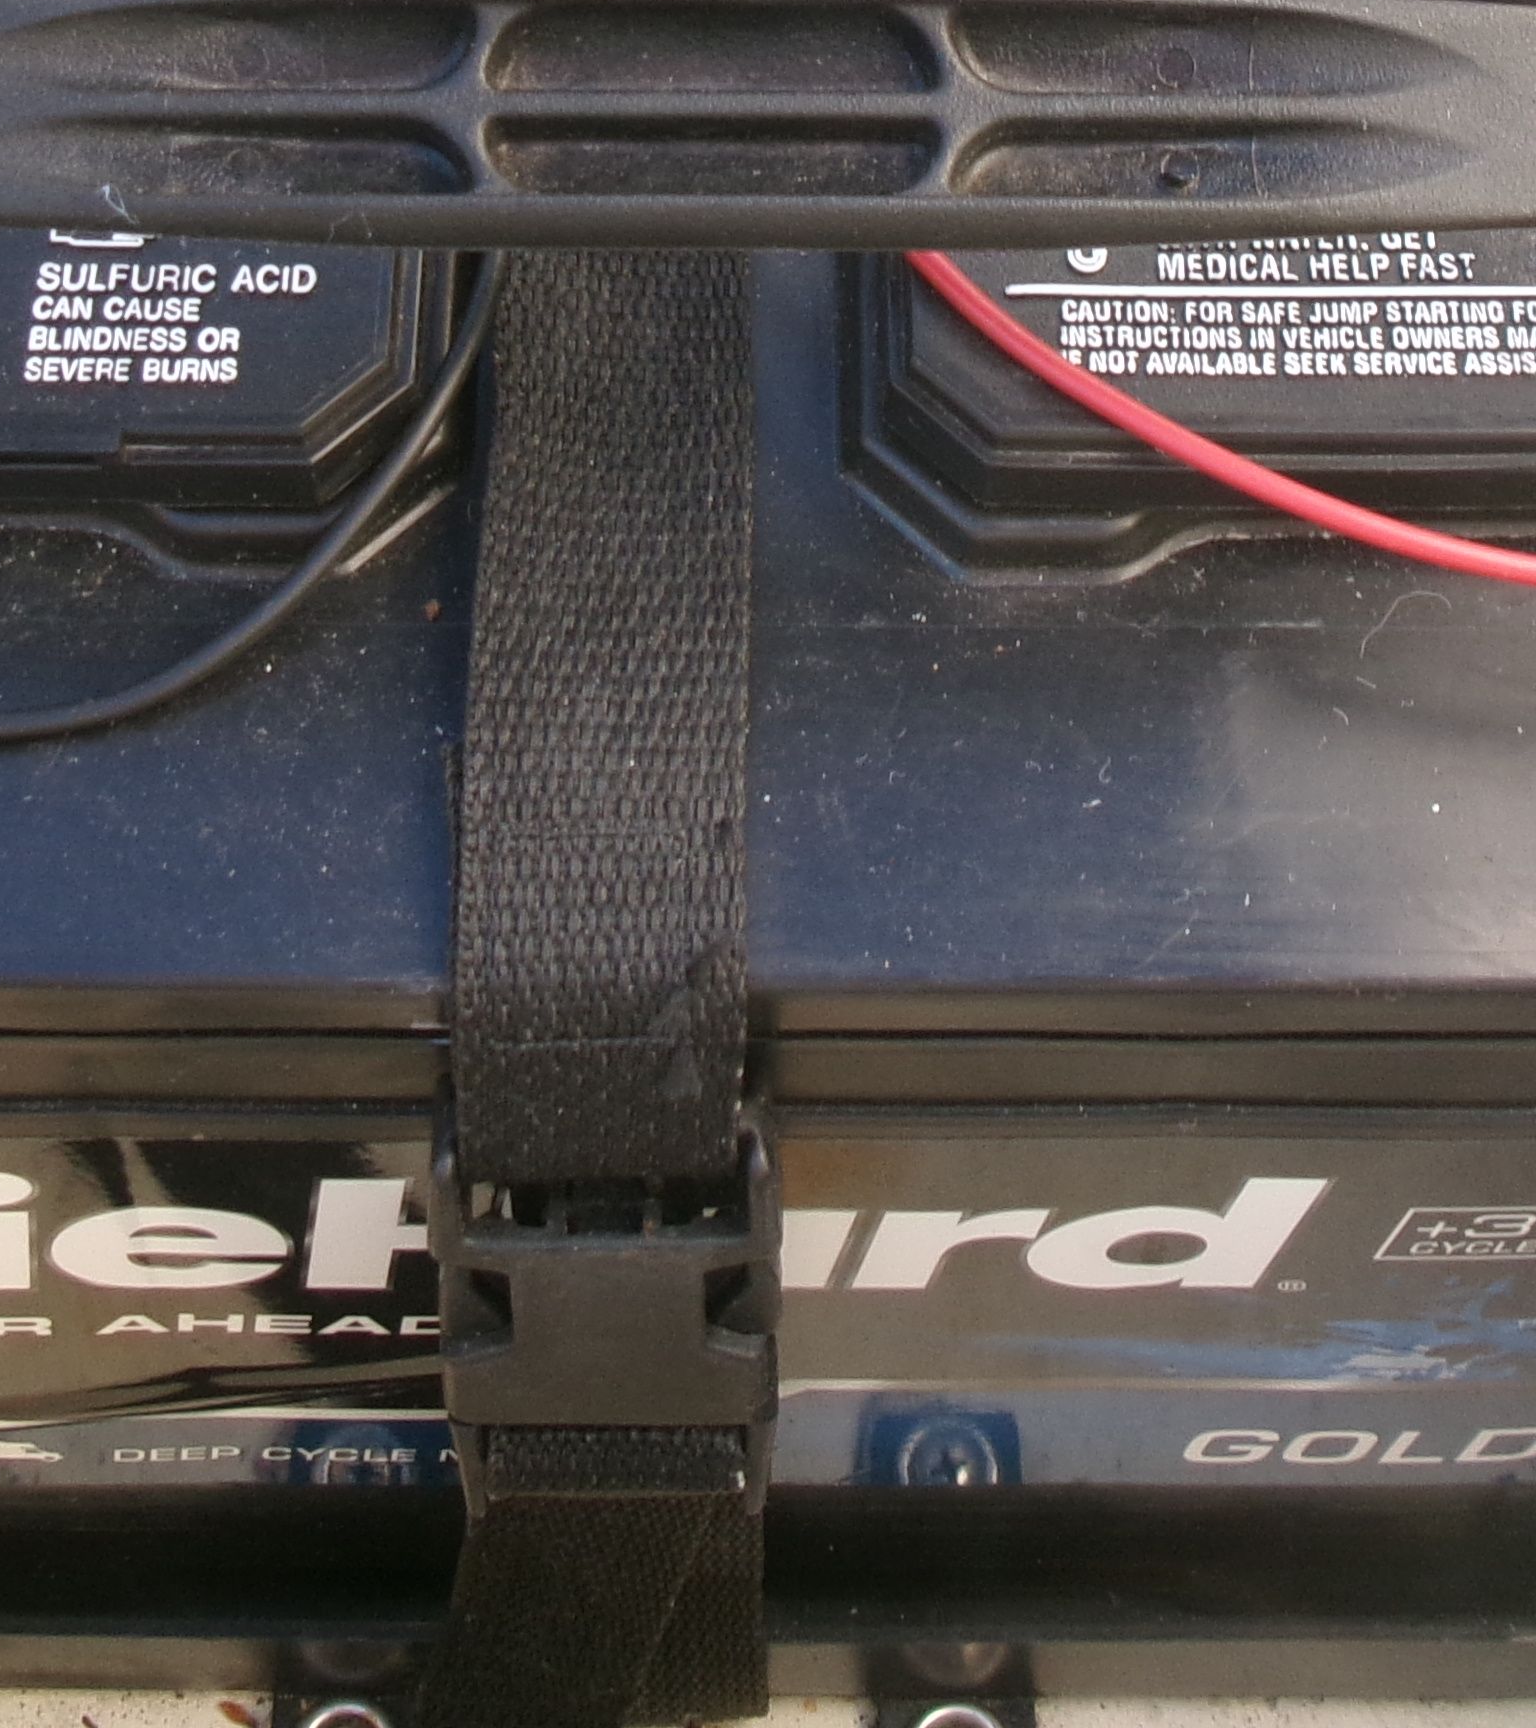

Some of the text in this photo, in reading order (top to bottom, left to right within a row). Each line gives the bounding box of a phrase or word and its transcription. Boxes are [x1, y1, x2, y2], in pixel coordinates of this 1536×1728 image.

[37, 263, 318, 295] SULFURIC ACID
[1157, 252, 1474, 281] MEDICAL HELP FAST
[32, 296, 201, 323] CAN CAUSE
[1061, 300, 1176, 324] CAUTION:
[1185, 301, 1233, 324] FOR
[1241, 301, 1301, 324] SAFE
[1309, 301, 1378, 324] JUMP
[1386, 301, 1505, 324] STARTING
[28, 326, 241, 354] BLINDNESS OR
[1060, 326, 1242, 349] INSTRUCTIONS
[1250, 327, 1275, 349] IN
[1282, 327, 1384, 349] VEHICLE
[1392, 326, 1500, 349] OWNERS
[24, 357, 239, 383] SEVERE BURNS
[1089, 352, 1139, 374] NOT
[1147, 351, 1276, 375] AVAILABLE
[1284, 352, 1347, 375] SEEK
[1354, 352, 1457, 375] SERVICE
[97, 1312, 443, 1337] AHEAD
[112, 1446, 417, 1463] DEEP CYCLE
